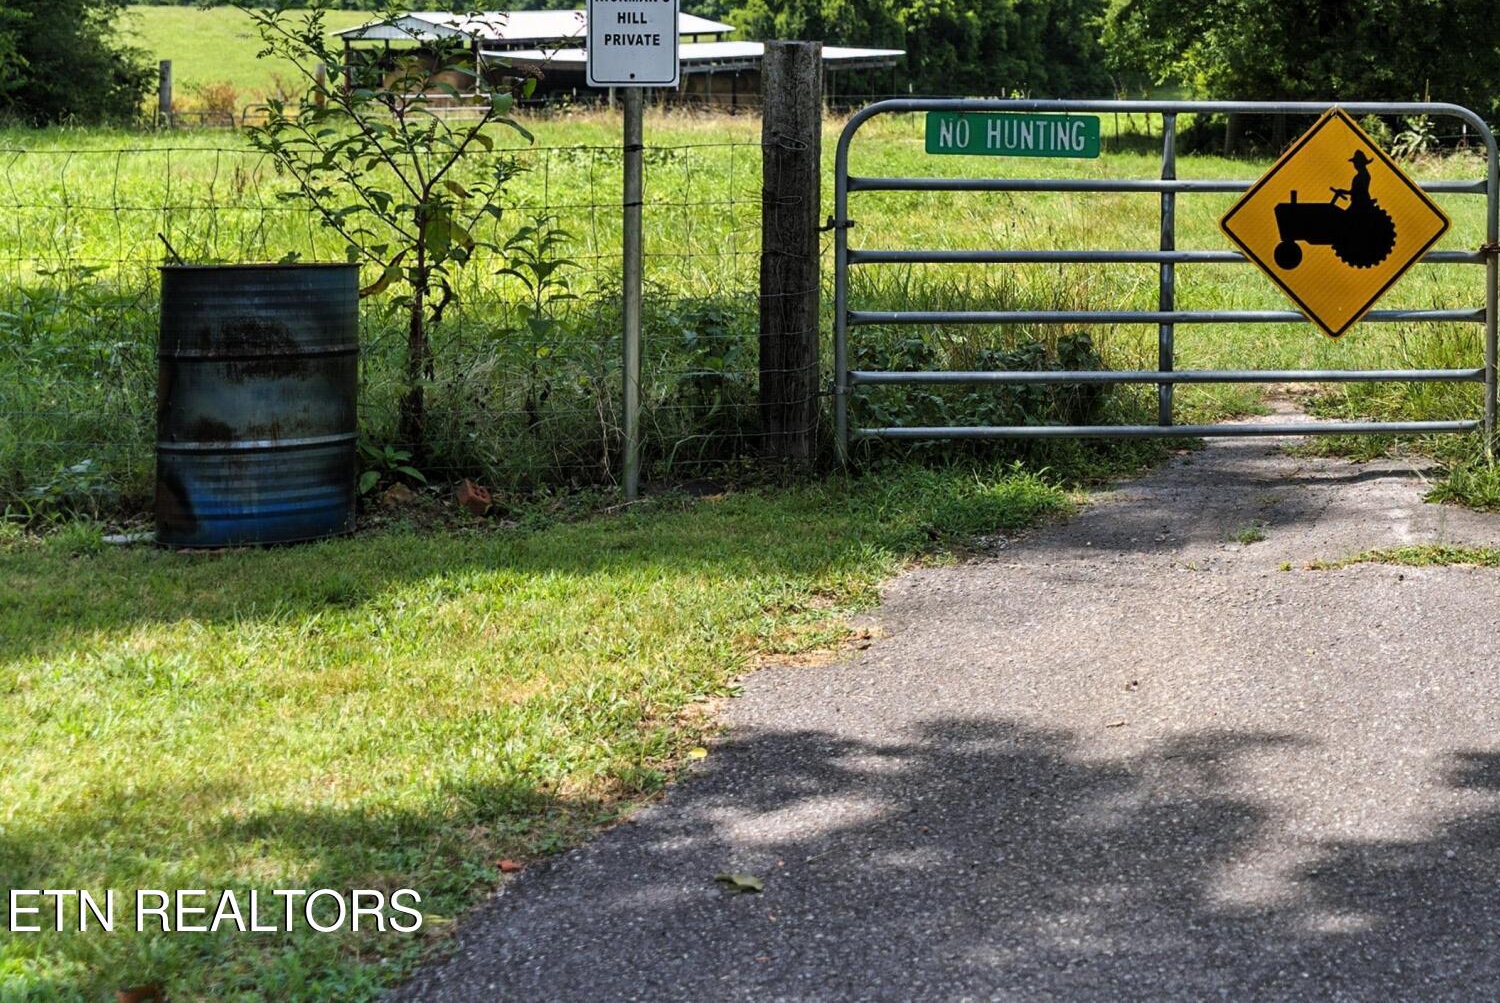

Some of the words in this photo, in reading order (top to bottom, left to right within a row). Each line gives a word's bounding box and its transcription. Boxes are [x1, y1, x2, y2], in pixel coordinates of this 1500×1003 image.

[617, 12, 648, 24] HILL
[604, 34, 661, 46] PRIVATE
[939, 118, 970, 148] NO
[986, 119, 1086, 151] HUNTING
